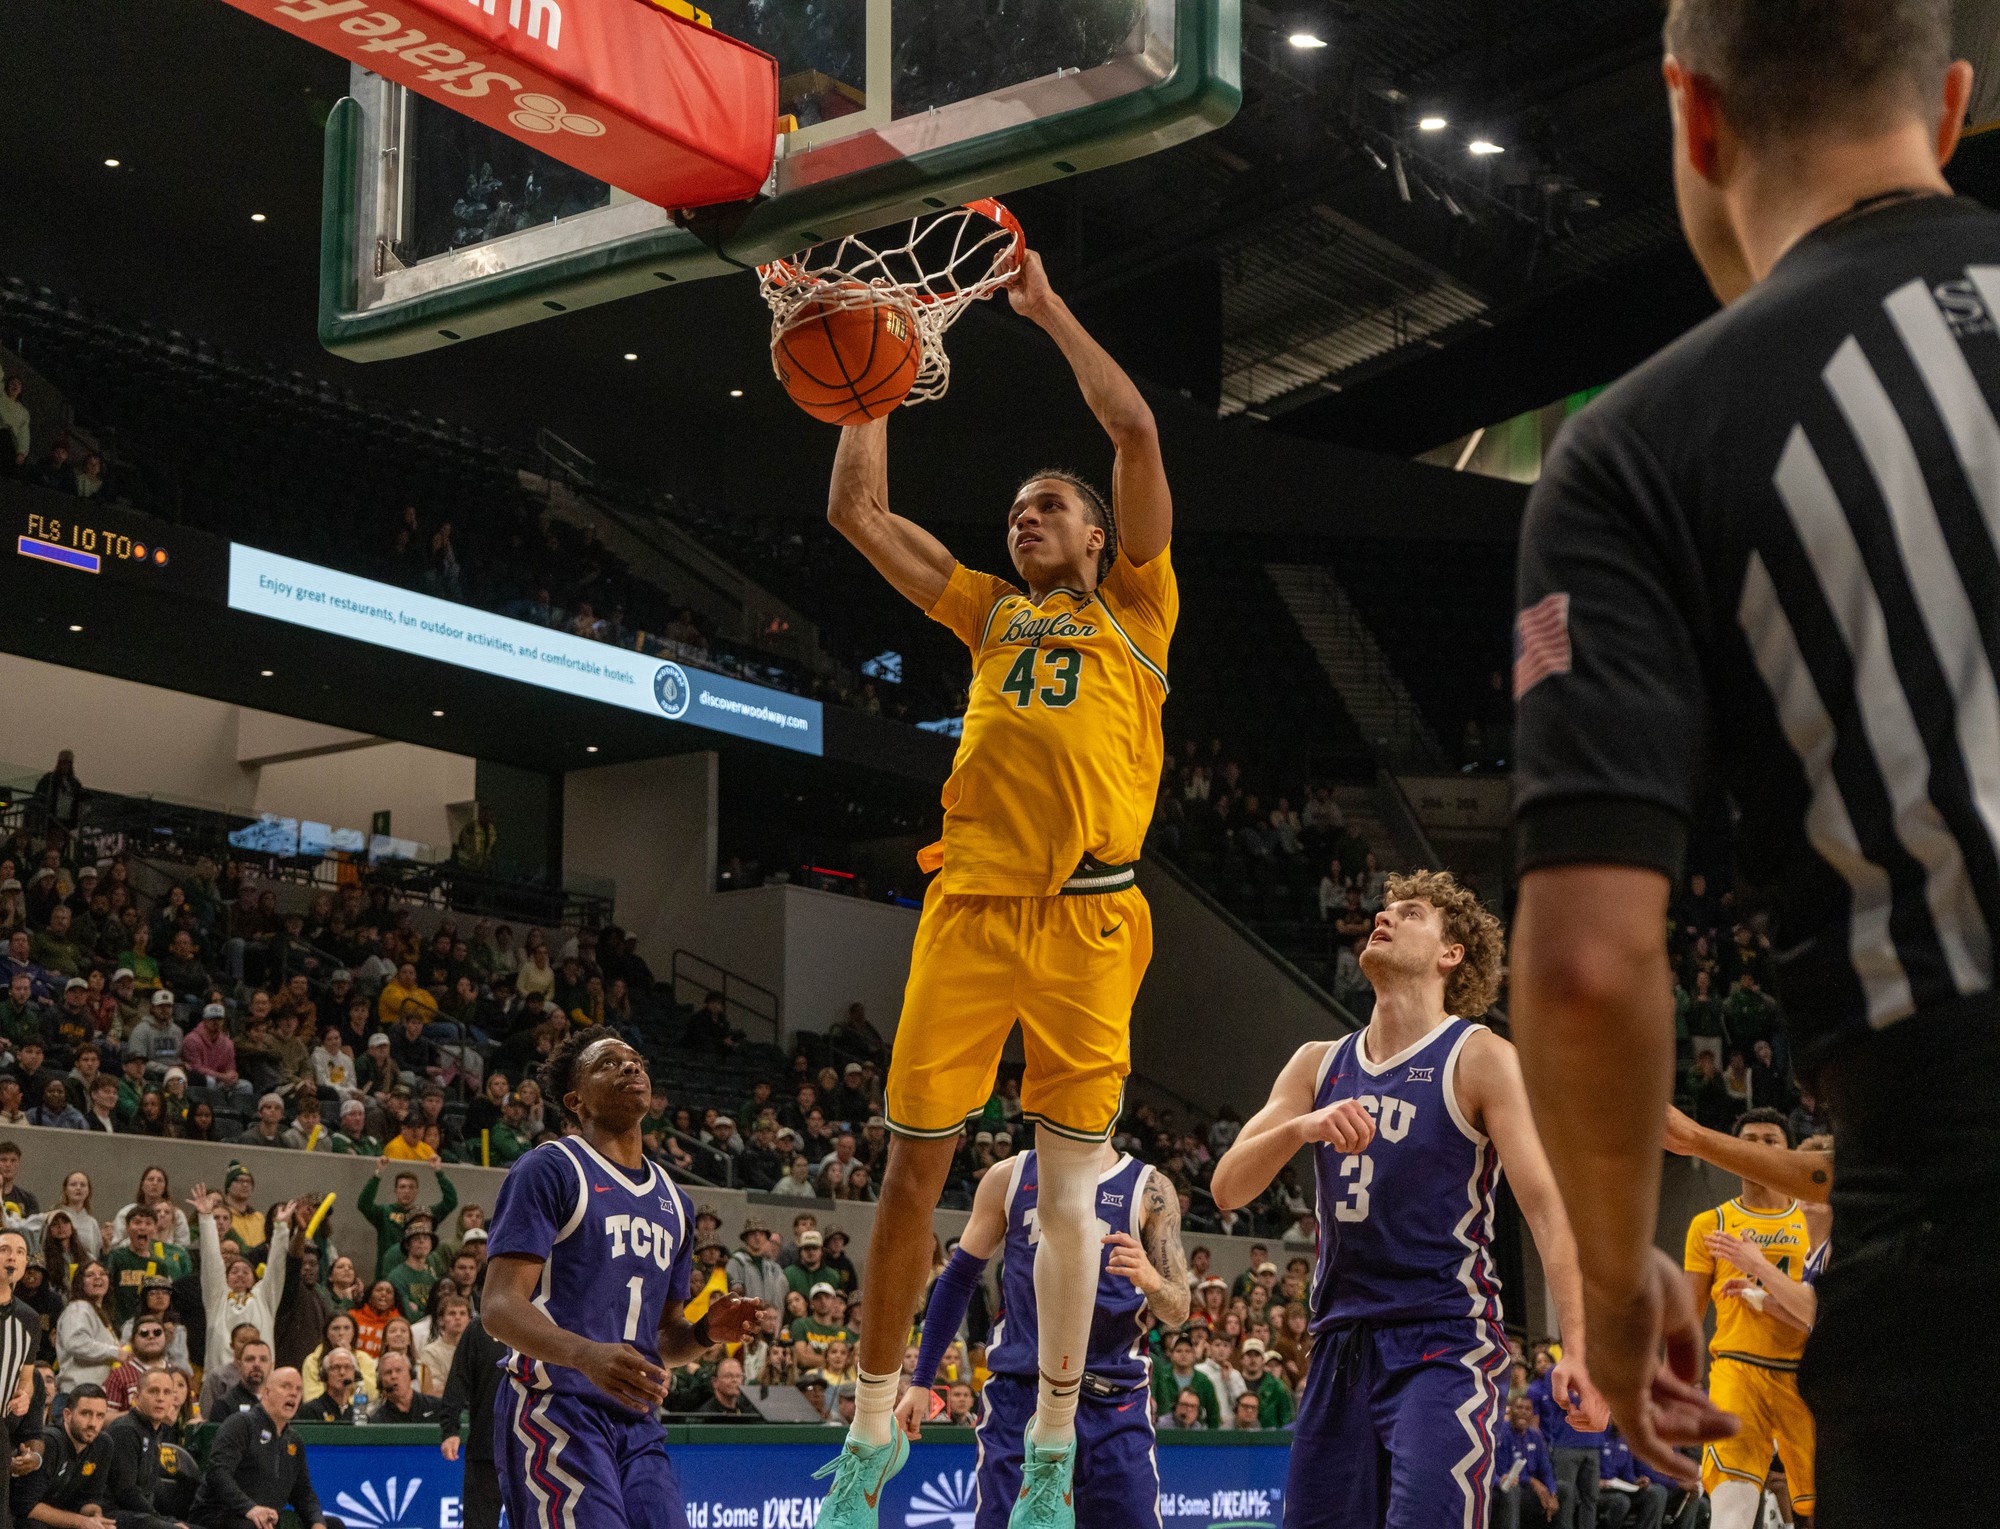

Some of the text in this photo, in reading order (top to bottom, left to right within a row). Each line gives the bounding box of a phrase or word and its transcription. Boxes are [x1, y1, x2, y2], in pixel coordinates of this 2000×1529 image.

[273, 0, 522, 97] StateF
[28, 513, 61, 541] FLS
[102, 531, 132, 559] TO
[259, 574, 636, 685] Enjoy great restaurants, fun outdoor activities, and comfortable hotels.
[1000, 609, 1098, 647] Baylor
[1001, 646, 1083, 708] 43
[699, 690, 808, 731] discoverwoodway.com
[1325, 1095, 1417, 1147] CU
[1335, 1154, 1375, 1223] 3
[605, 1214, 673, 1271] TCU
[626, 1275, 644, 1341] 1
[712, 1502, 759, 1528] Some
[1177, 1493, 1211, 1516] Some
